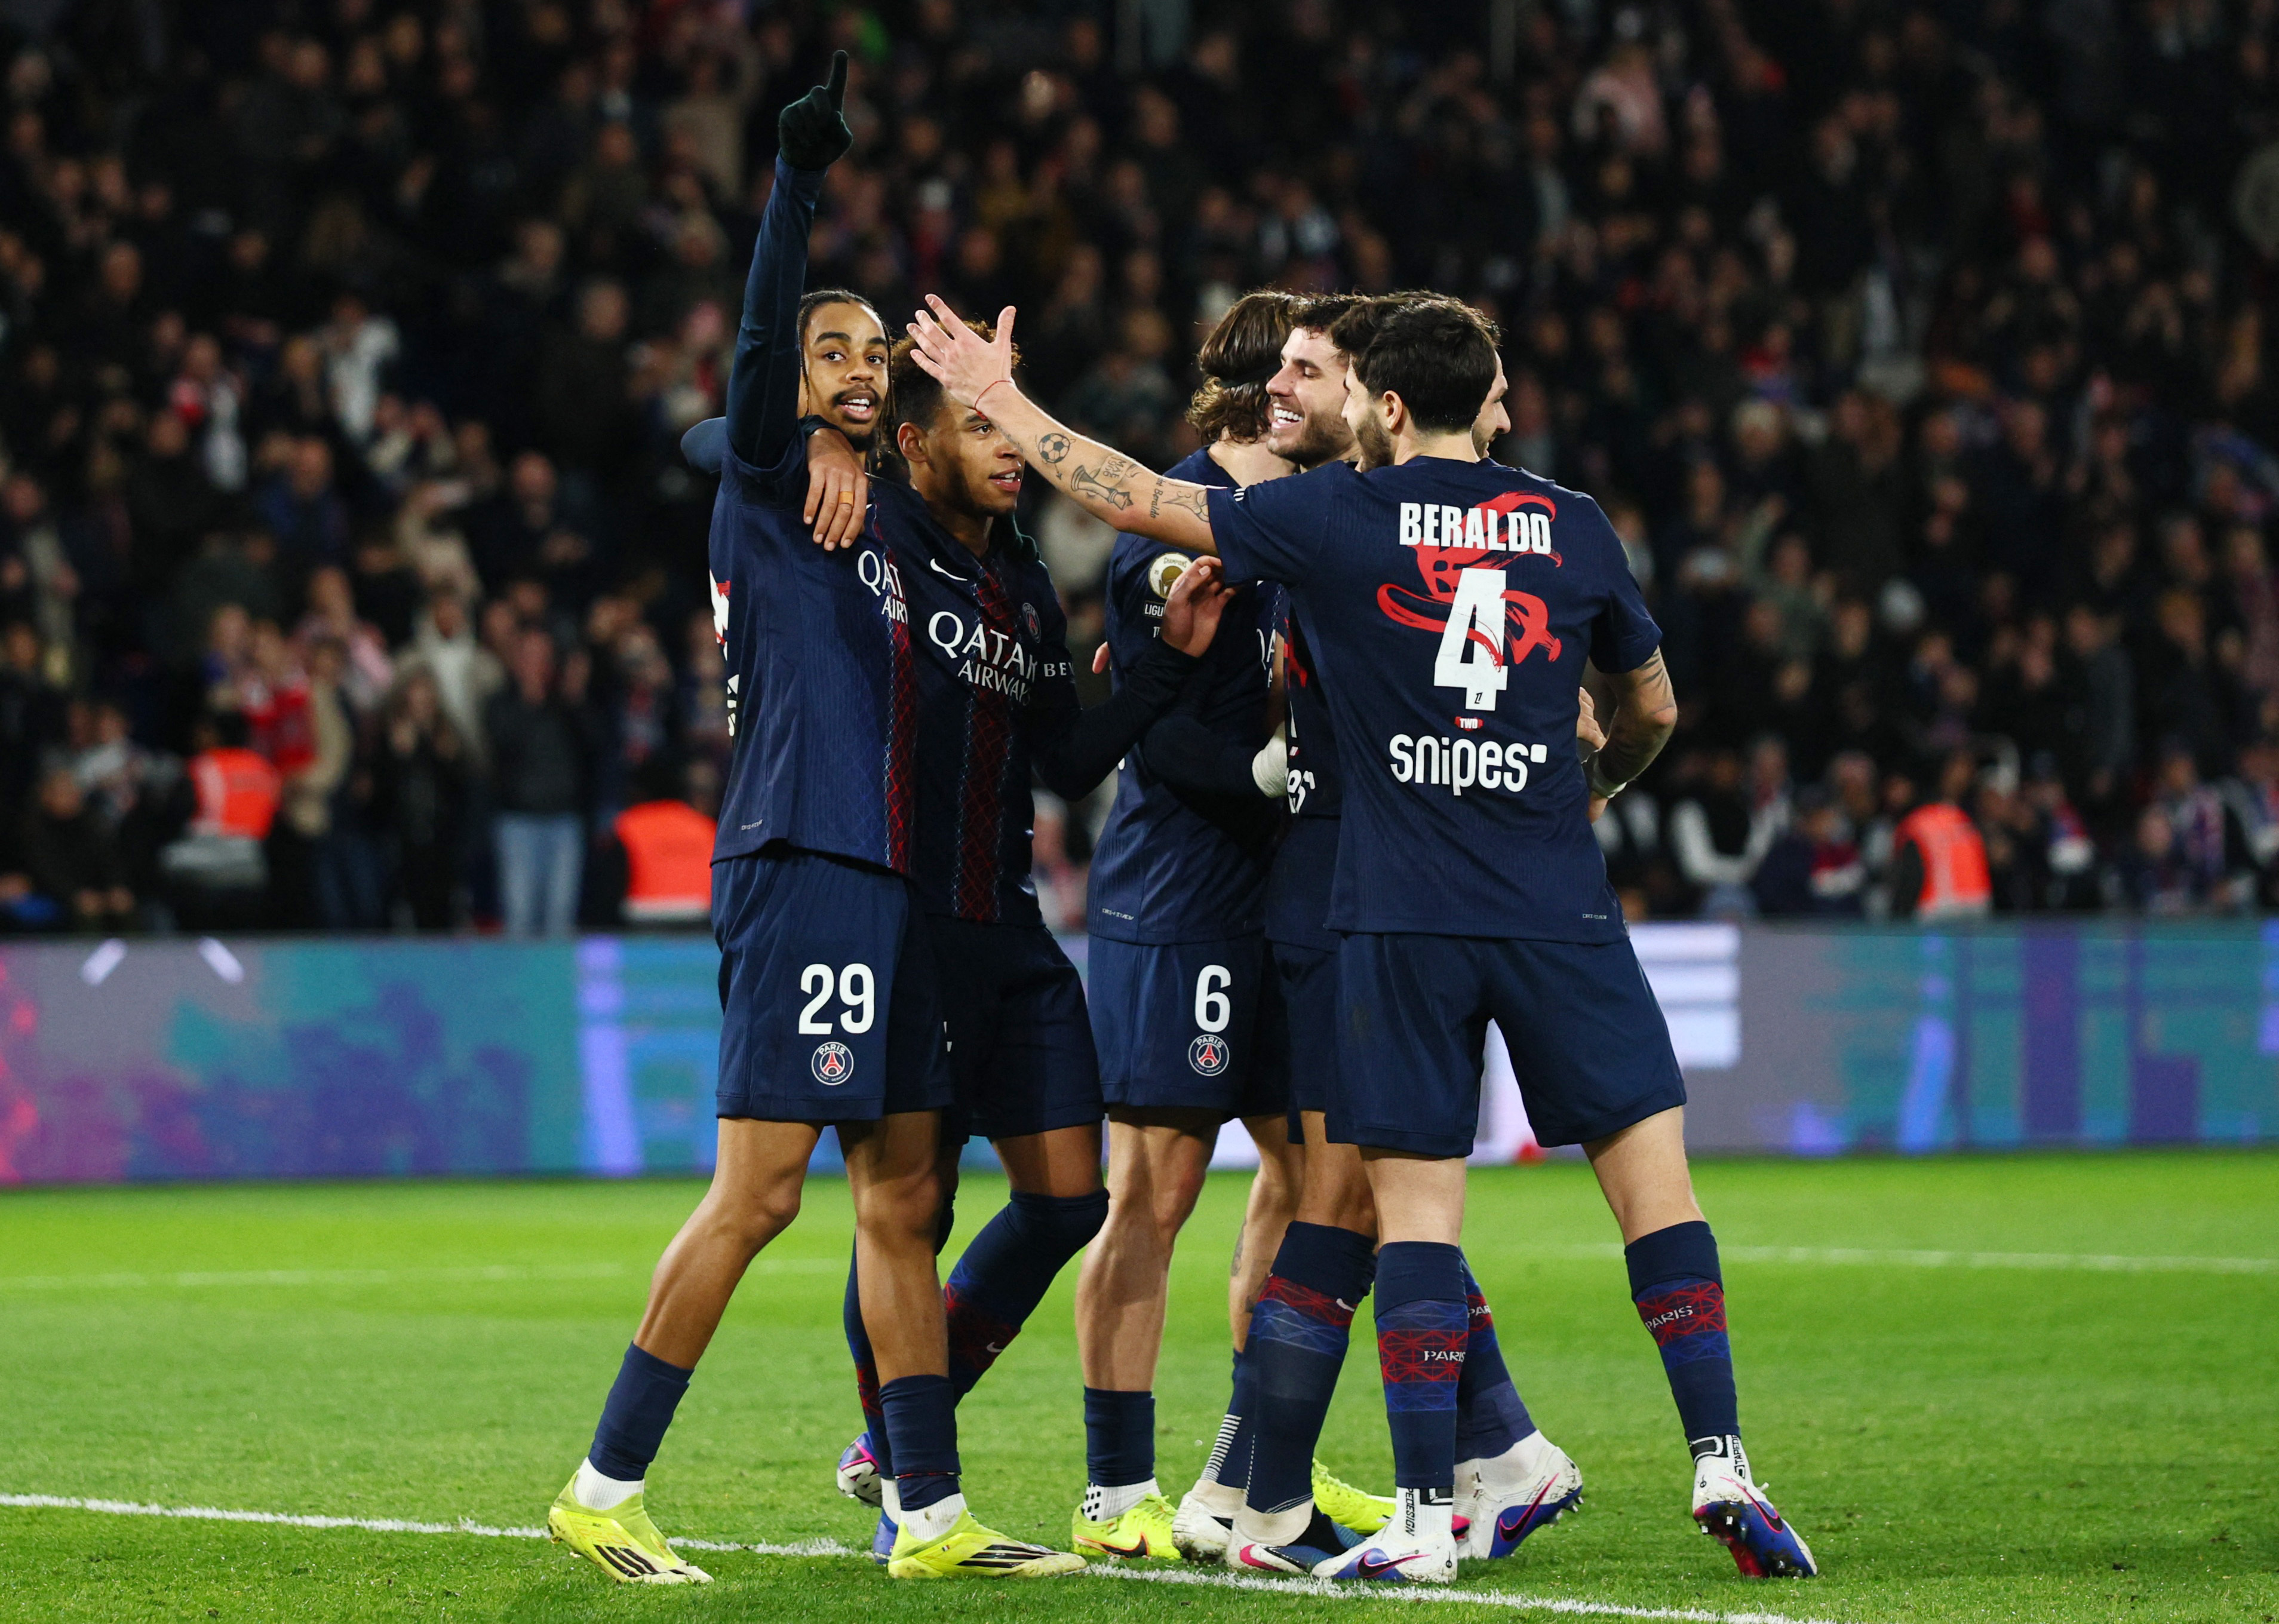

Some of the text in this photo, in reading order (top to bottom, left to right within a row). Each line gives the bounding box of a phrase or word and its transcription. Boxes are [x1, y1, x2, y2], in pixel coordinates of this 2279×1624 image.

[1399, 502, 1552, 555] BERALDO
[858, 550, 906, 601] QAT
[881, 595, 908, 625] AIR
[1144, 603, 1164, 617] LIGU
[1434, 567, 1509, 711] 4
[1389, 733, 1529, 796] snipes
[798, 963, 875, 1034] 29
[1195, 965, 1231, 1033] 6
[818, 1043, 846, 1055] PARIS
[1196, 1036, 1224, 1048] PARIS
[1645, 1306, 1693, 1332] PARIS
[1424, 1350, 1466, 1362] PARIS
